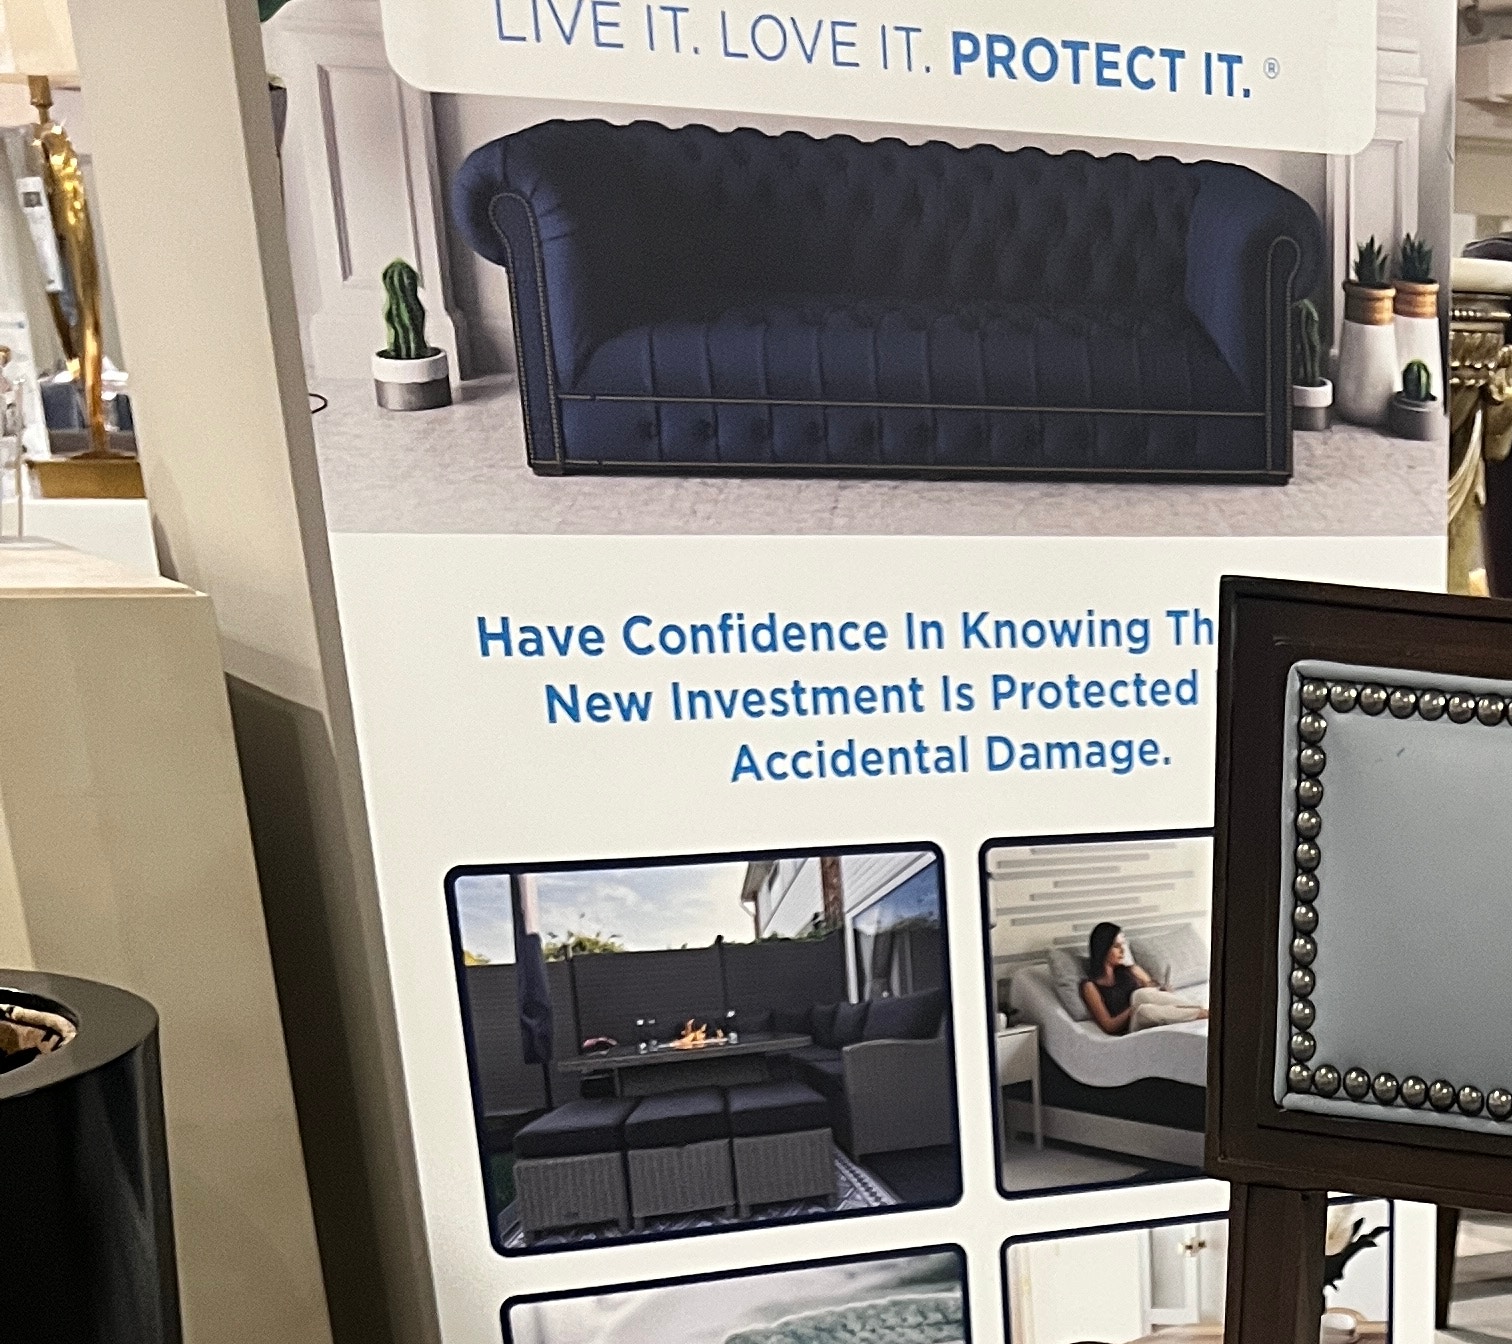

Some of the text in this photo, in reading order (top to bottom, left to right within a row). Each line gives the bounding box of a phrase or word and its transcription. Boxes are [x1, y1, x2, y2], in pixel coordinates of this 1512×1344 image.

[495, 0, 624, 49] LIVE
[646, 5, 700, 55] IT.
[720, 10, 860, 68] LOVE
[880, 24, 931, 74] IT.
[951, 30, 1186, 93] PROTECT
[1204, 51, 1251, 98] IT.
[477, 608, 1215, 657] Have Confidence In Knowing Th
[545, 668, 1198, 724] New Investment Is Protected
[730, 734, 1171, 783] Accidental Damage.
